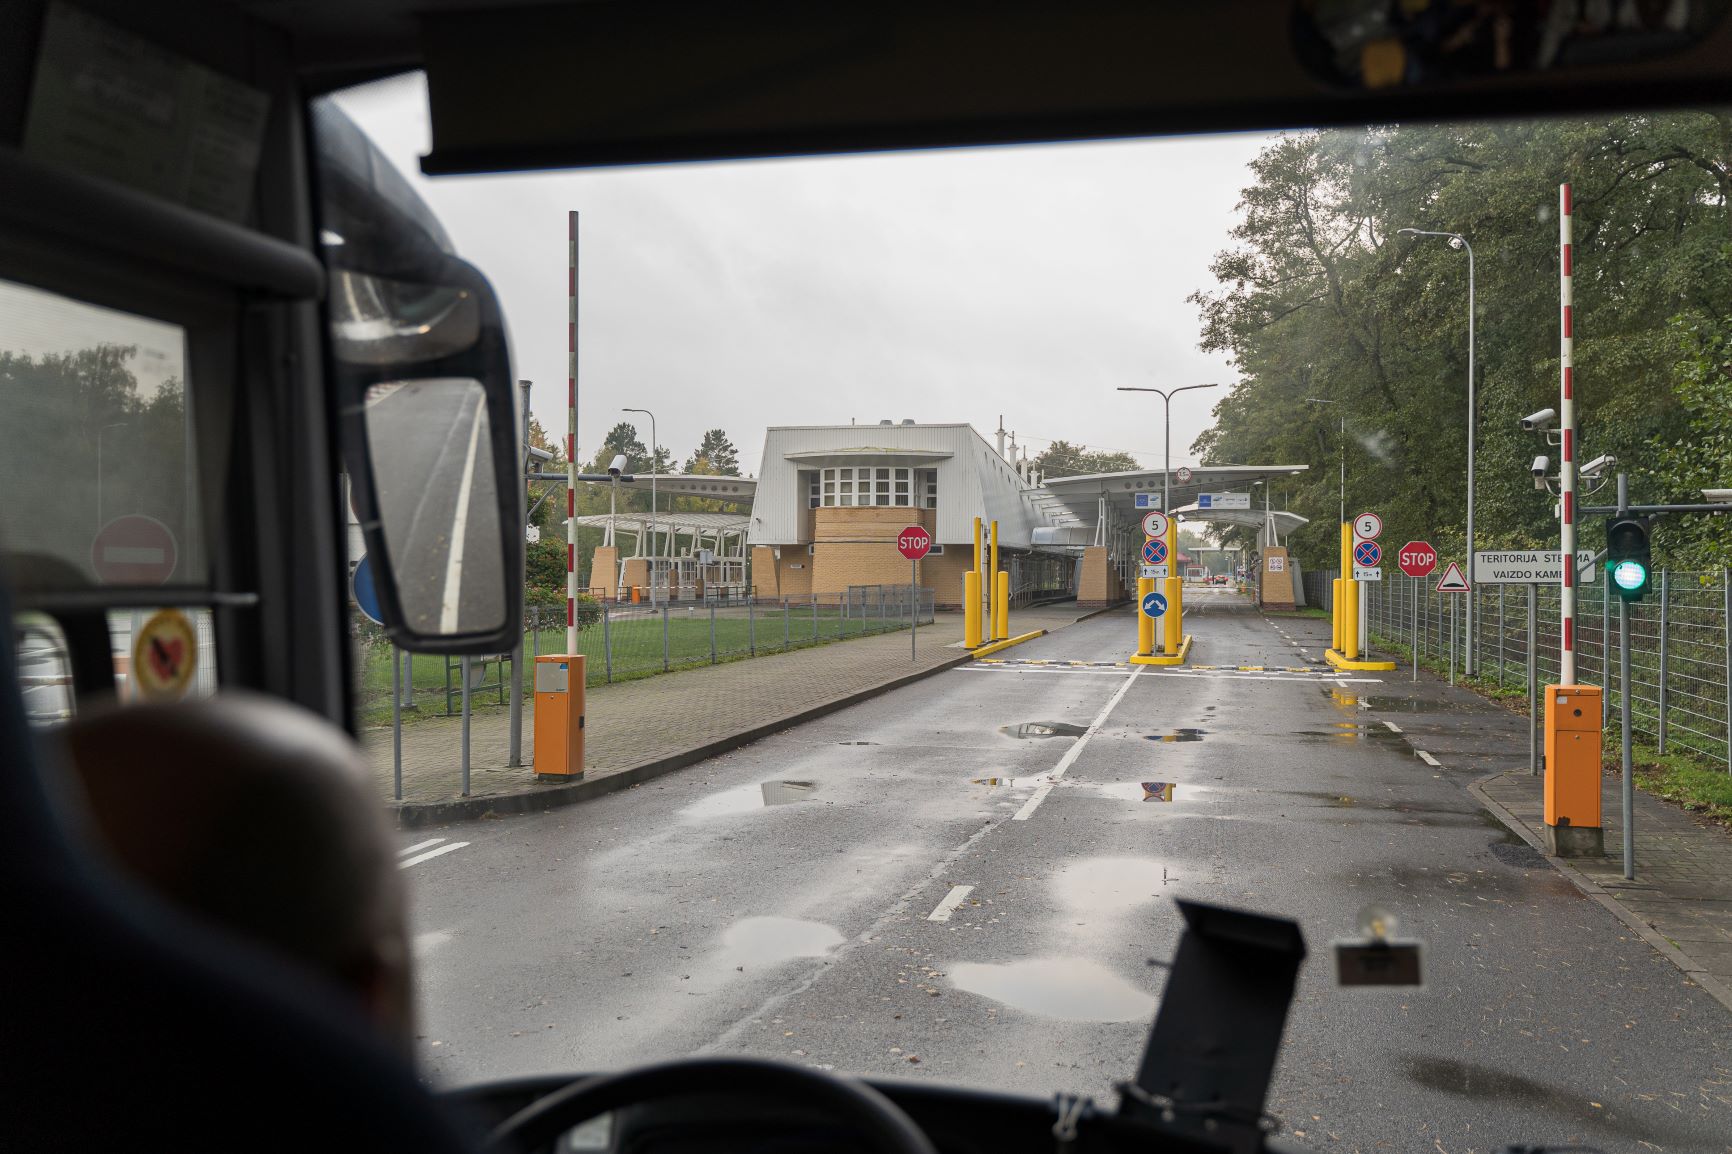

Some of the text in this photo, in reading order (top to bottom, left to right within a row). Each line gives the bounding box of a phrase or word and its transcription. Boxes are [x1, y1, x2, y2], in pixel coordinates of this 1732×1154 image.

[1151, 520, 1159, 531] 5
[1364, 521, 1372, 532] 5
[900, 536, 929, 550] STOP
[1401, 552, 1434, 566] STOP
[1481, 554, 1538, 563] TERITORIJA
[1493, 570, 1532, 579] VAIZDO
